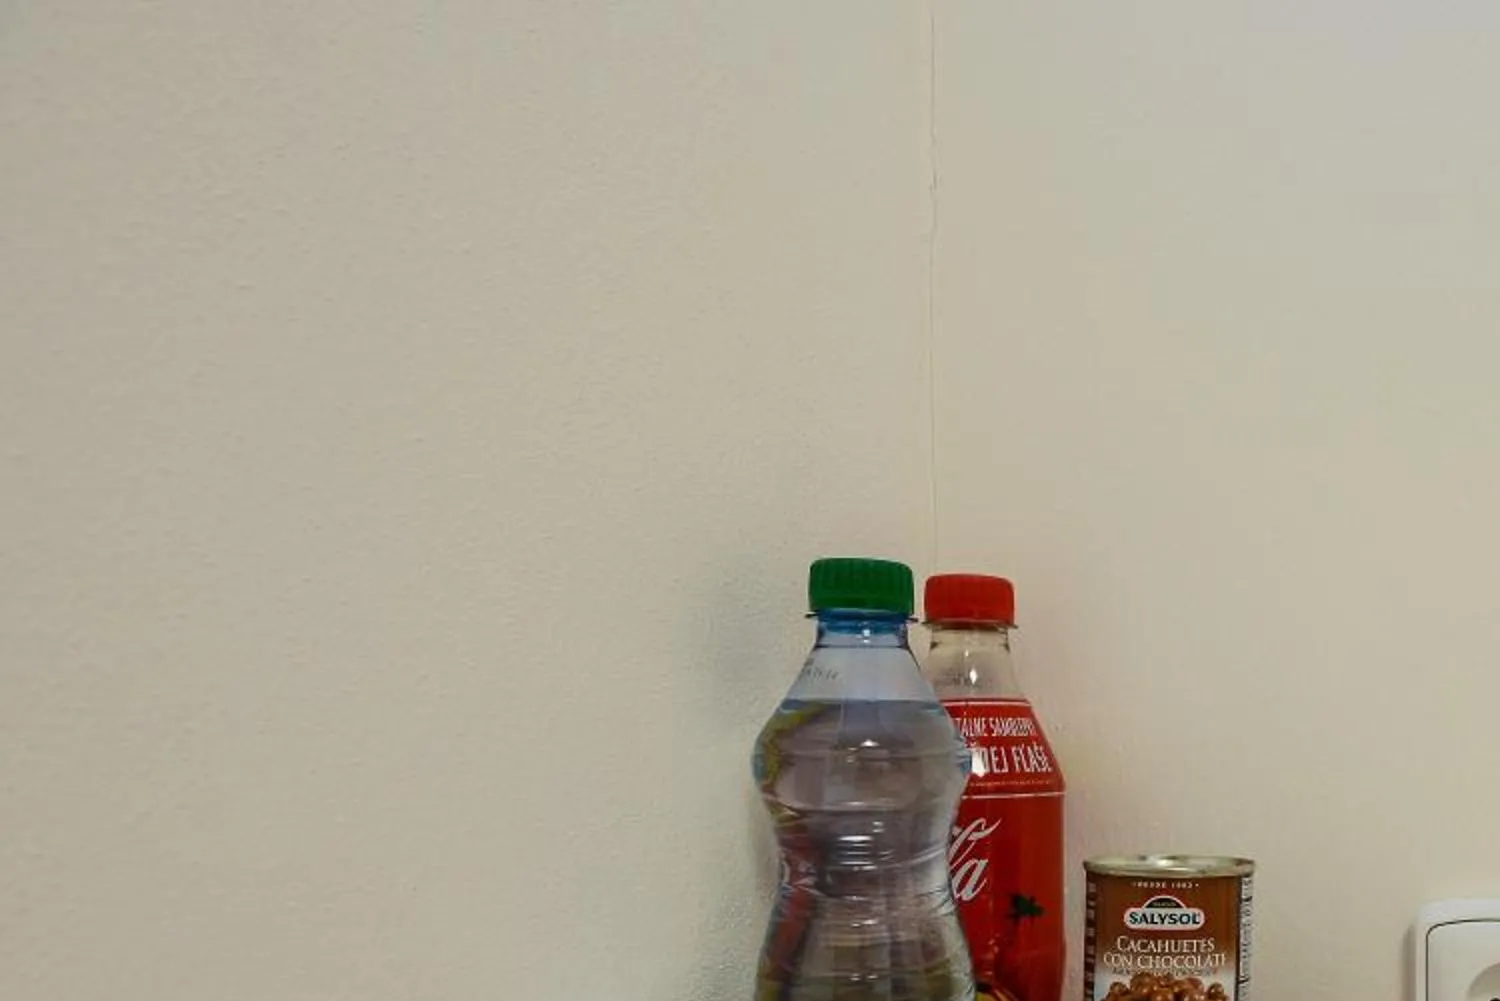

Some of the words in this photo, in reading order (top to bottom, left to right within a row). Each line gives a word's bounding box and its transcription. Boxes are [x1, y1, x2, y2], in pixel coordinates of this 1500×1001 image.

[1129, 911, 1200, 925] SALYSOL
[1117, 936, 1216, 953] CACAHUETES
[1103, 952, 1133, 967] CON
